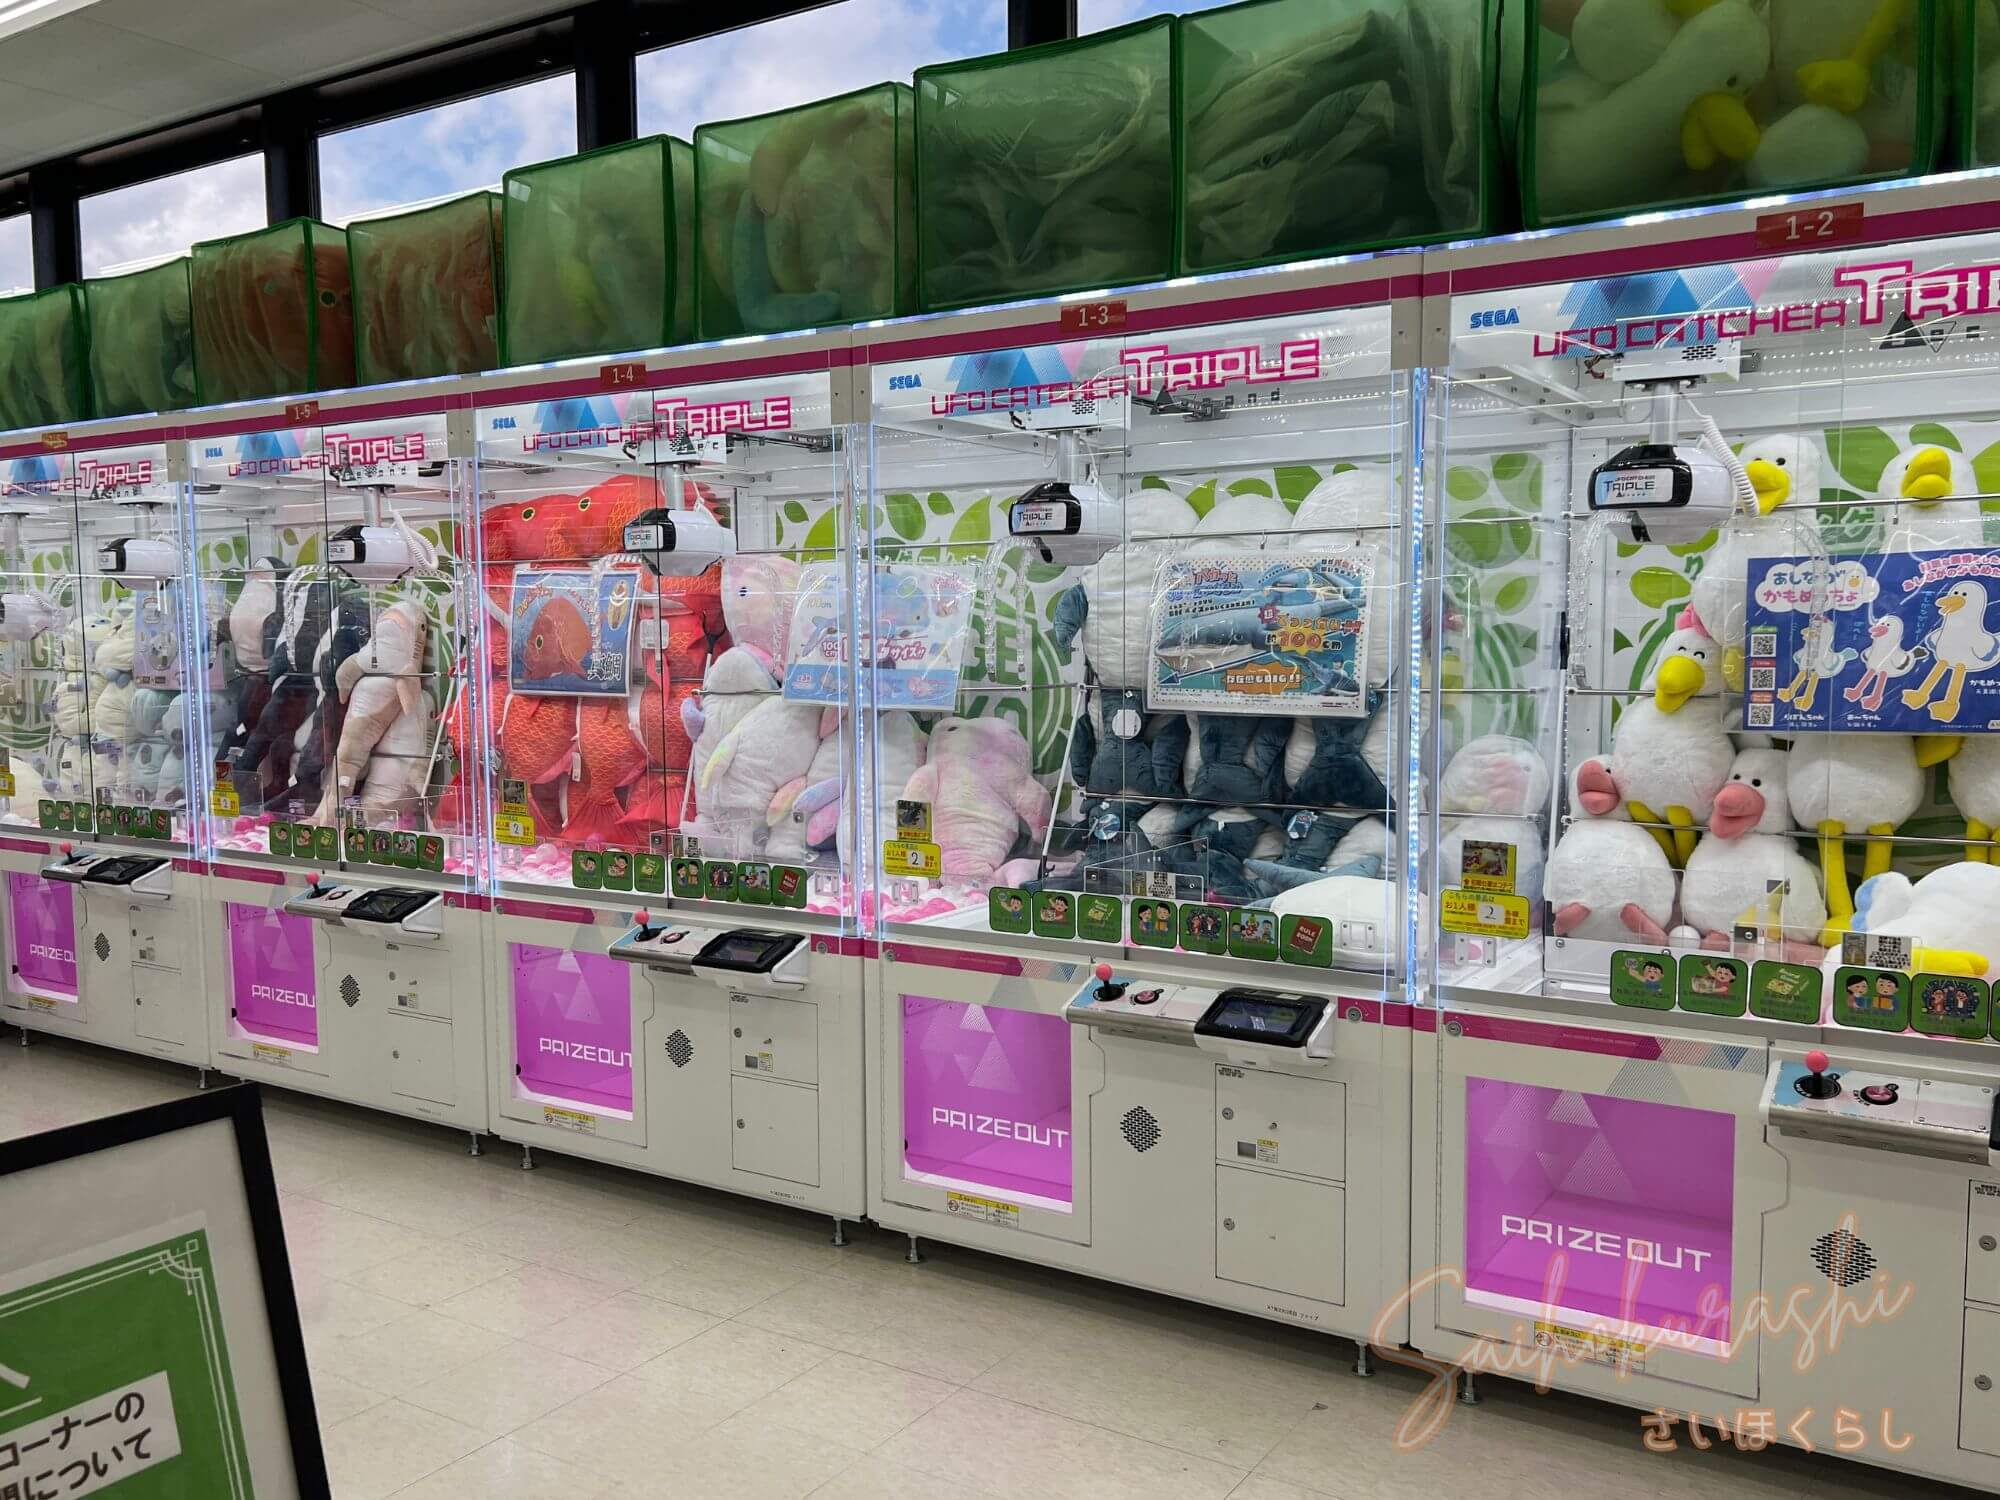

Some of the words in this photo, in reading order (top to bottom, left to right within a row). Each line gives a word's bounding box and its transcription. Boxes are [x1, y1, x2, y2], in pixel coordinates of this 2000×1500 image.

[1785, 211, 1834, 240] 1-2
[1078, 306, 1110, 327] 1-3
[1470, 308, 1520, 329] SEGA
[1533, 322, 1618, 358] UFO
[1625, 299, 1847, 348] CATCHER
[612, 367, 634, 383] 1-4
[889, 373, 922, 390] SEGA
[931, 391, 988, 416] UFO
[990, 376, 1131, 410] CATCHER
[1121, 339, 1321, 396] TRIPLE
[294, 404, 311, 419] 1-5
[492, 416, 517, 430] SEGA
[523, 431, 563, 452] UFO
[655, 397, 792, 440] TRIPLE
[324, 433, 425, 467] TRIPLE
[80, 459, 152, 488] TRIPLE
[1602, 480, 1656, 493] TRIPLE
[1763, 589, 1860, 603] かもめちょ
[911, 851, 919, 866] 2
